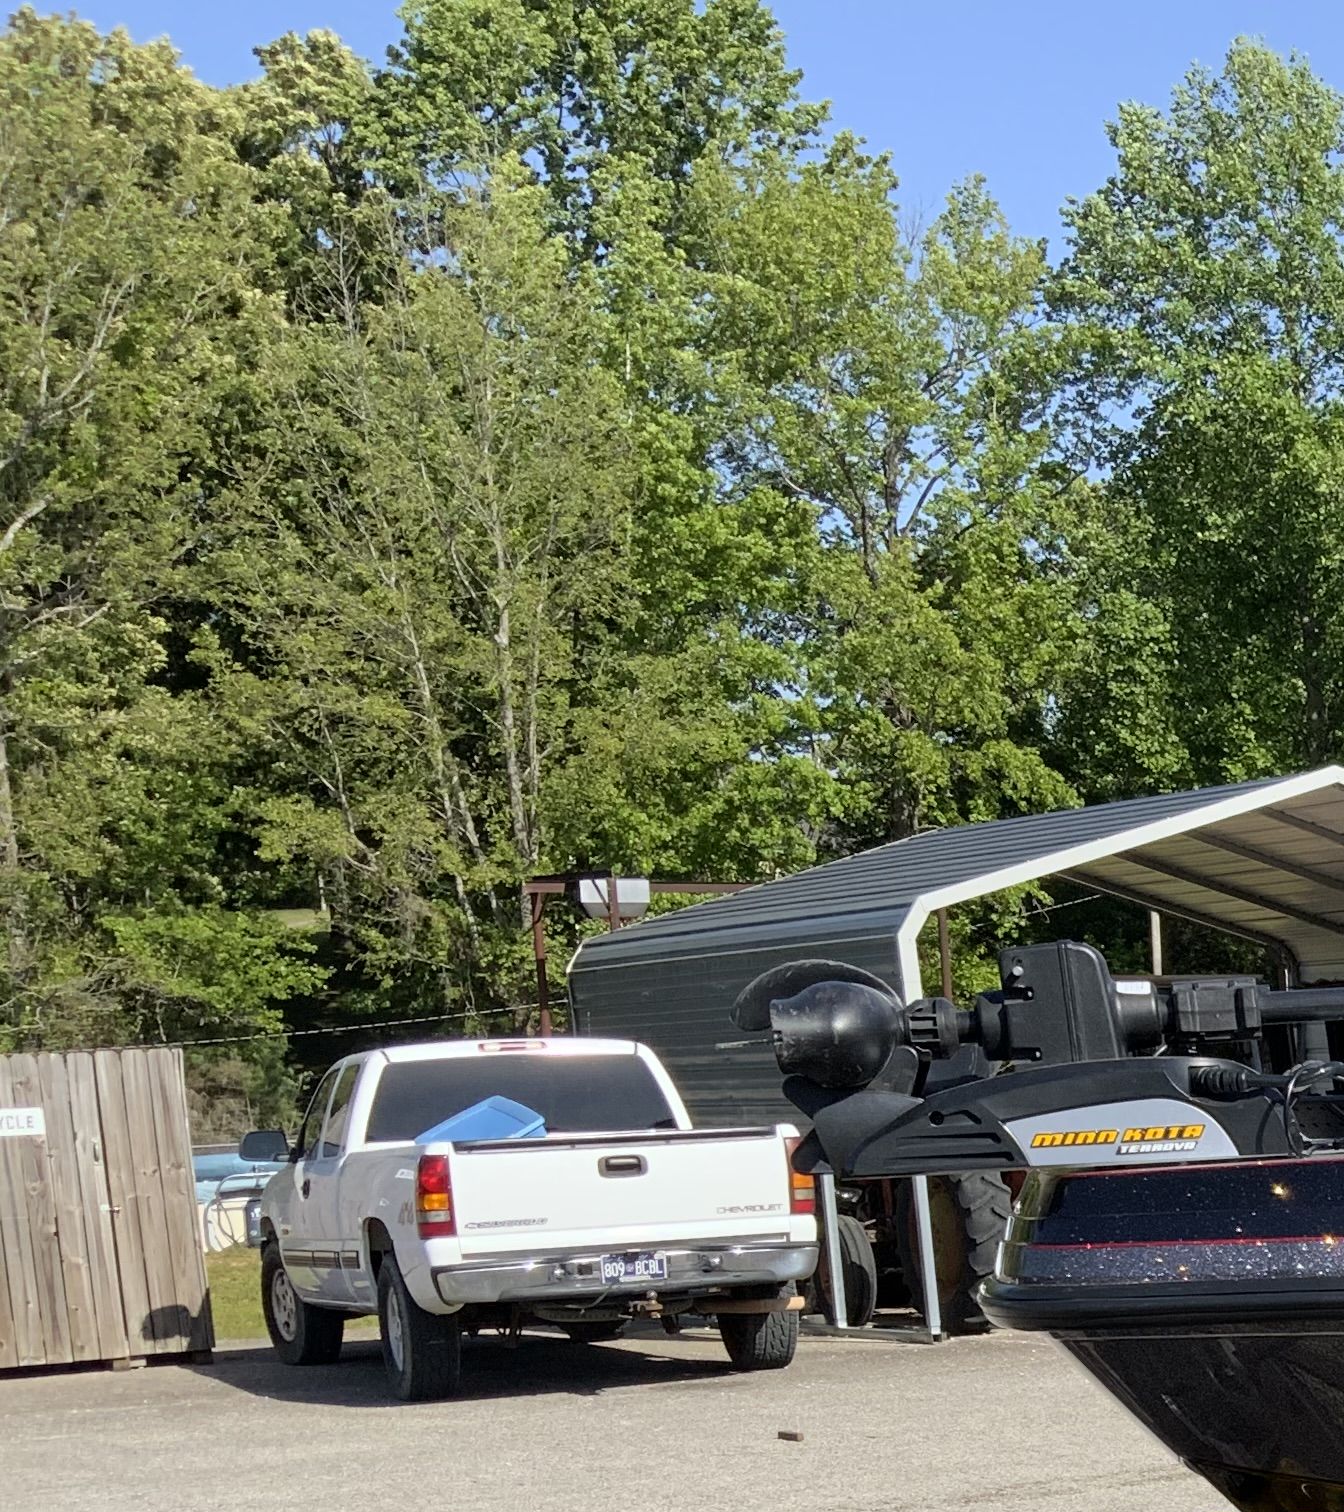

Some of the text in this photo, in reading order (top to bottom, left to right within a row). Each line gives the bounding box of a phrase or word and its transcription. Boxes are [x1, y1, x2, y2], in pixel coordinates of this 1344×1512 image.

[1031, 1124, 1205, 1148] MINN KOTA
[717, 1204, 784, 1214] CHEVROLET
[604, 1261, 625, 1278] 809
